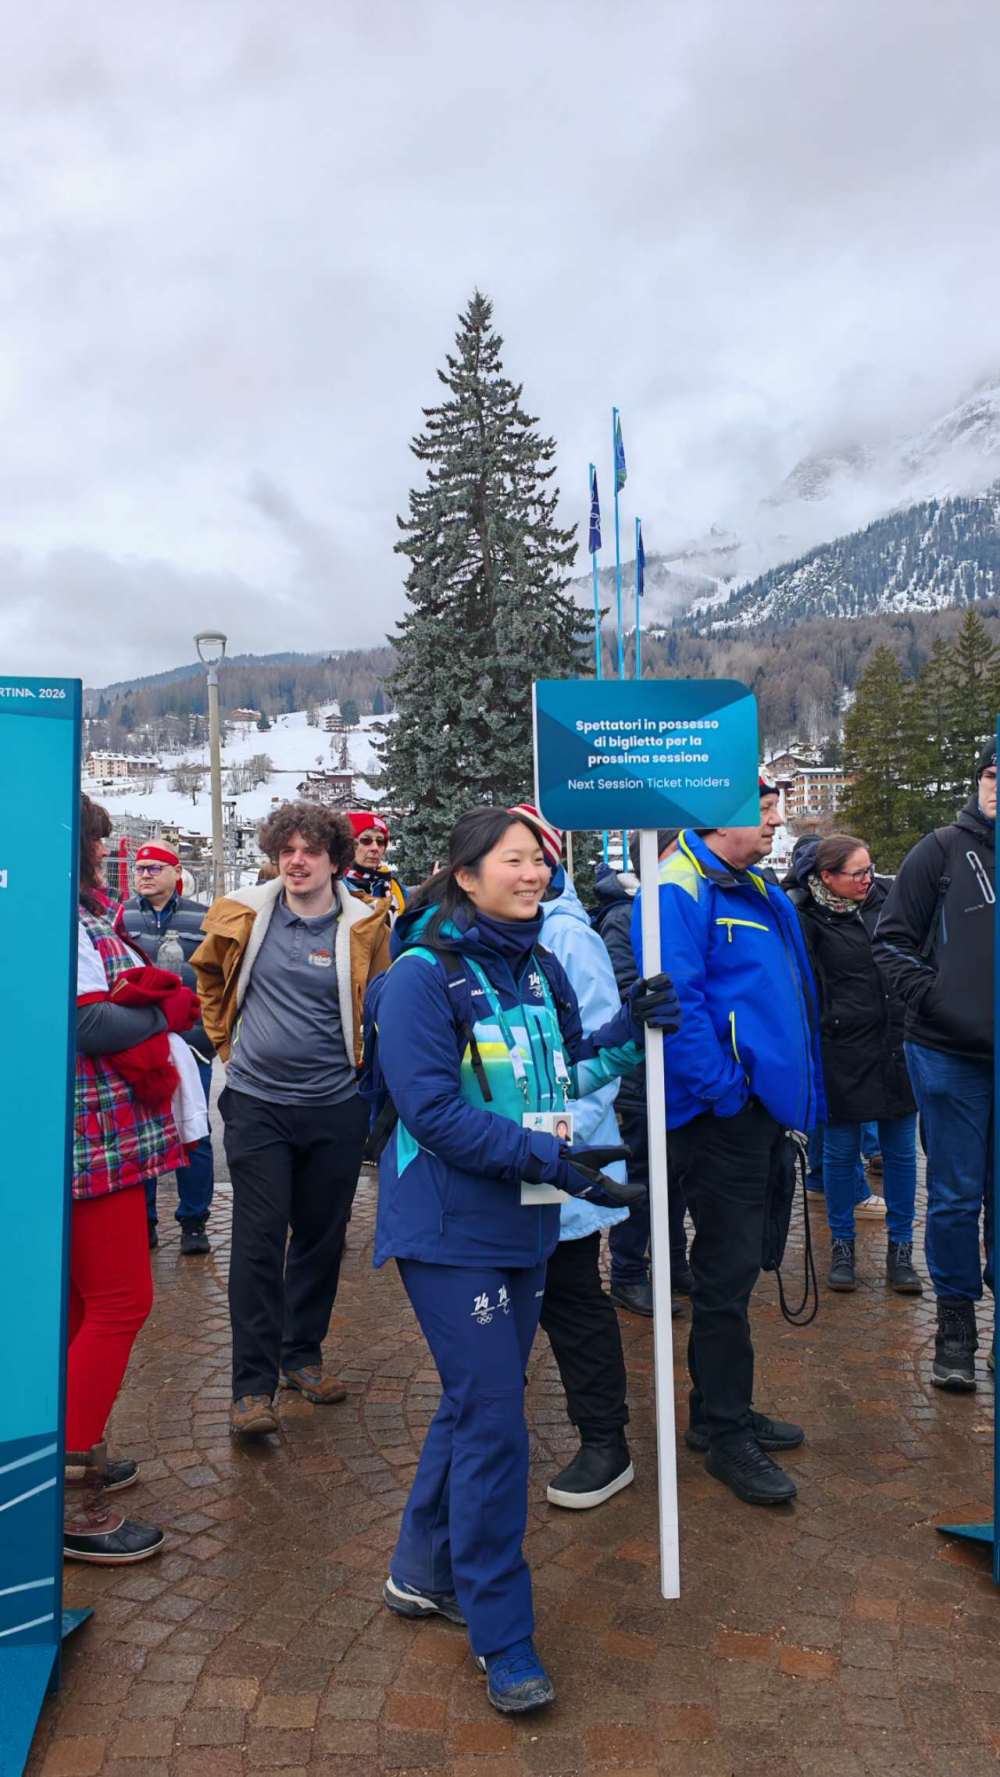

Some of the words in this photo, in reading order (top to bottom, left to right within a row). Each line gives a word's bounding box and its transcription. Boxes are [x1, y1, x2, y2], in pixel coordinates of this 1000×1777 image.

[38, 688, 66, 699] 2026
[575, 718, 642, 734] Spettatori
[643, 719, 656, 730] in
[658, 720, 719, 733] possesso
[593, 735, 606, 748] di
[608, 735, 663, 750] biglietto
[665, 737, 688, 749] per
[690, 735, 702, 746] la
[588, 752, 650, 768] prossima
[652, 751, 709, 764] sessione
[568, 779, 595, 790] Next
[597, 778, 644, 790] Session
[647, 777, 682, 788] Ticket
[684, 777, 731, 788] holders
